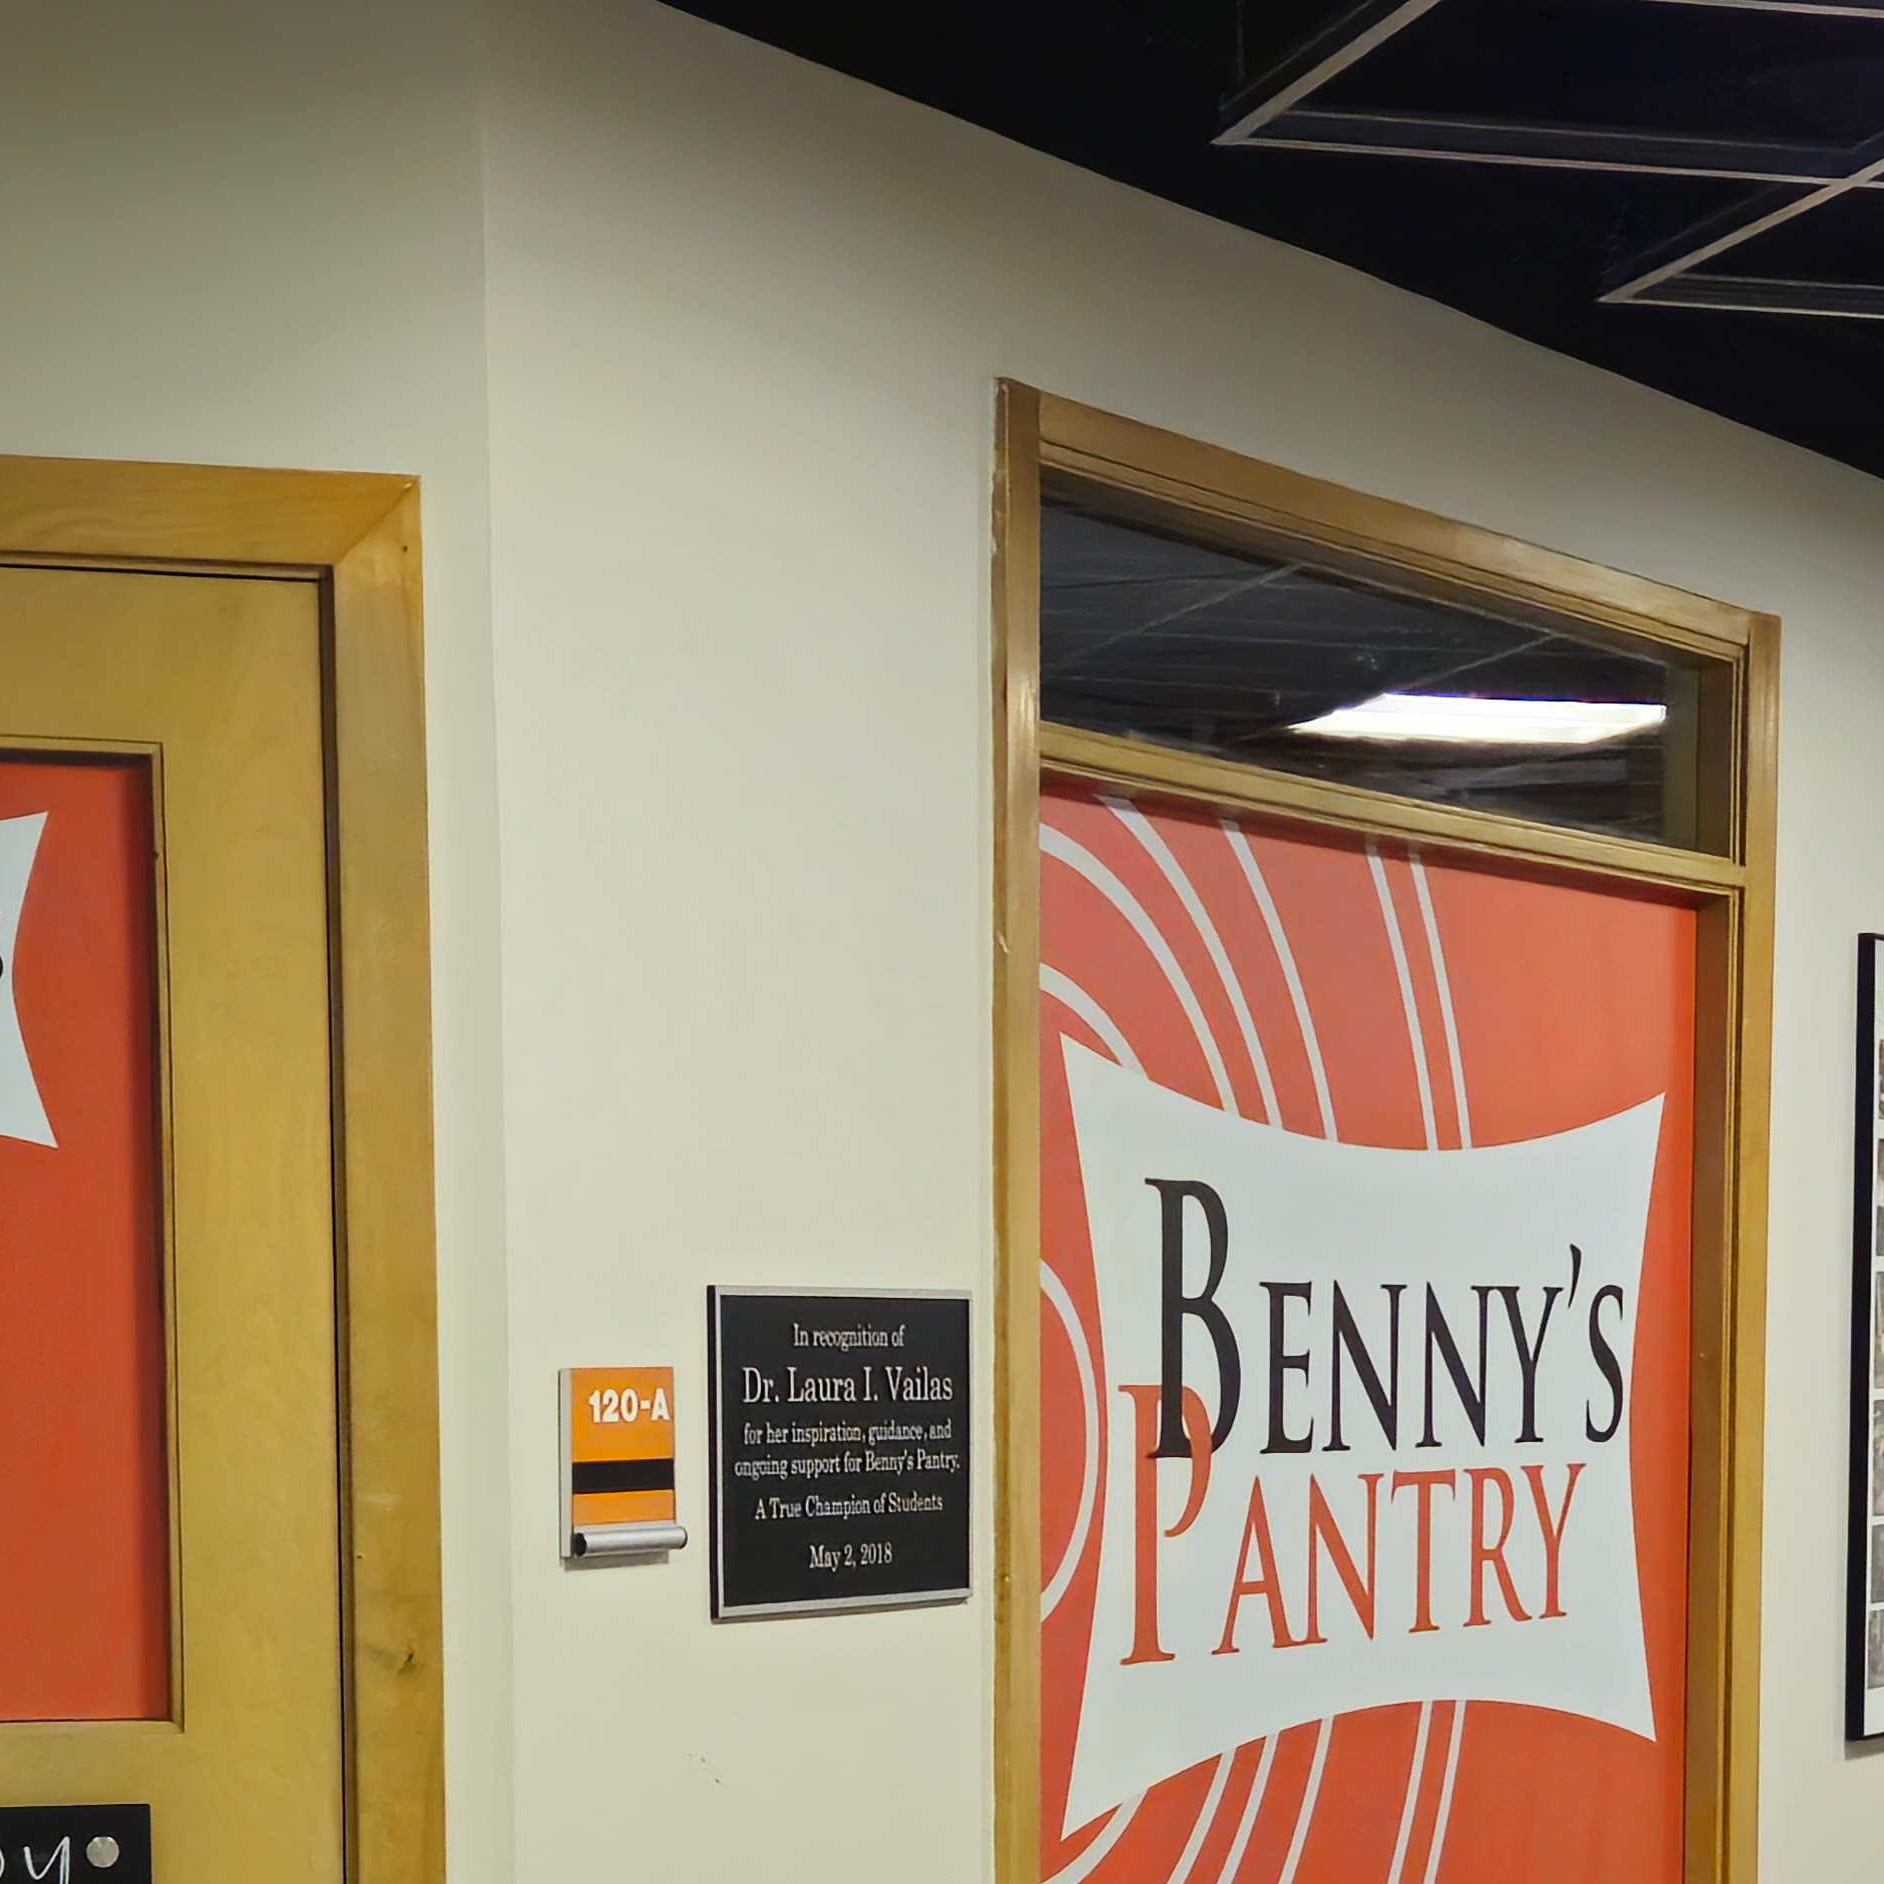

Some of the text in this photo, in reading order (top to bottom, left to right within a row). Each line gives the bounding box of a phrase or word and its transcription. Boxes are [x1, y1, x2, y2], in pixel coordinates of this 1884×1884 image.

[1143, 1176, 1625, 1460] BENNY'S
[793, 1323, 906, 1352] In recognition of
[741, 1366, 954, 1404] Dr. Laura I. Vailas
[587, 1387, 671, 1424] 120-A
[743, 1417, 952, 1448] for her inspiration, guidance, and
[734, 1448, 961, 1481] ongoing support for Benny's Pantry.
[754, 1491, 944, 1520] A True Champion of Students
[1117, 1383, 1587, 1666] PANTRY
[809, 1542, 893, 1573] May 2, 2018
